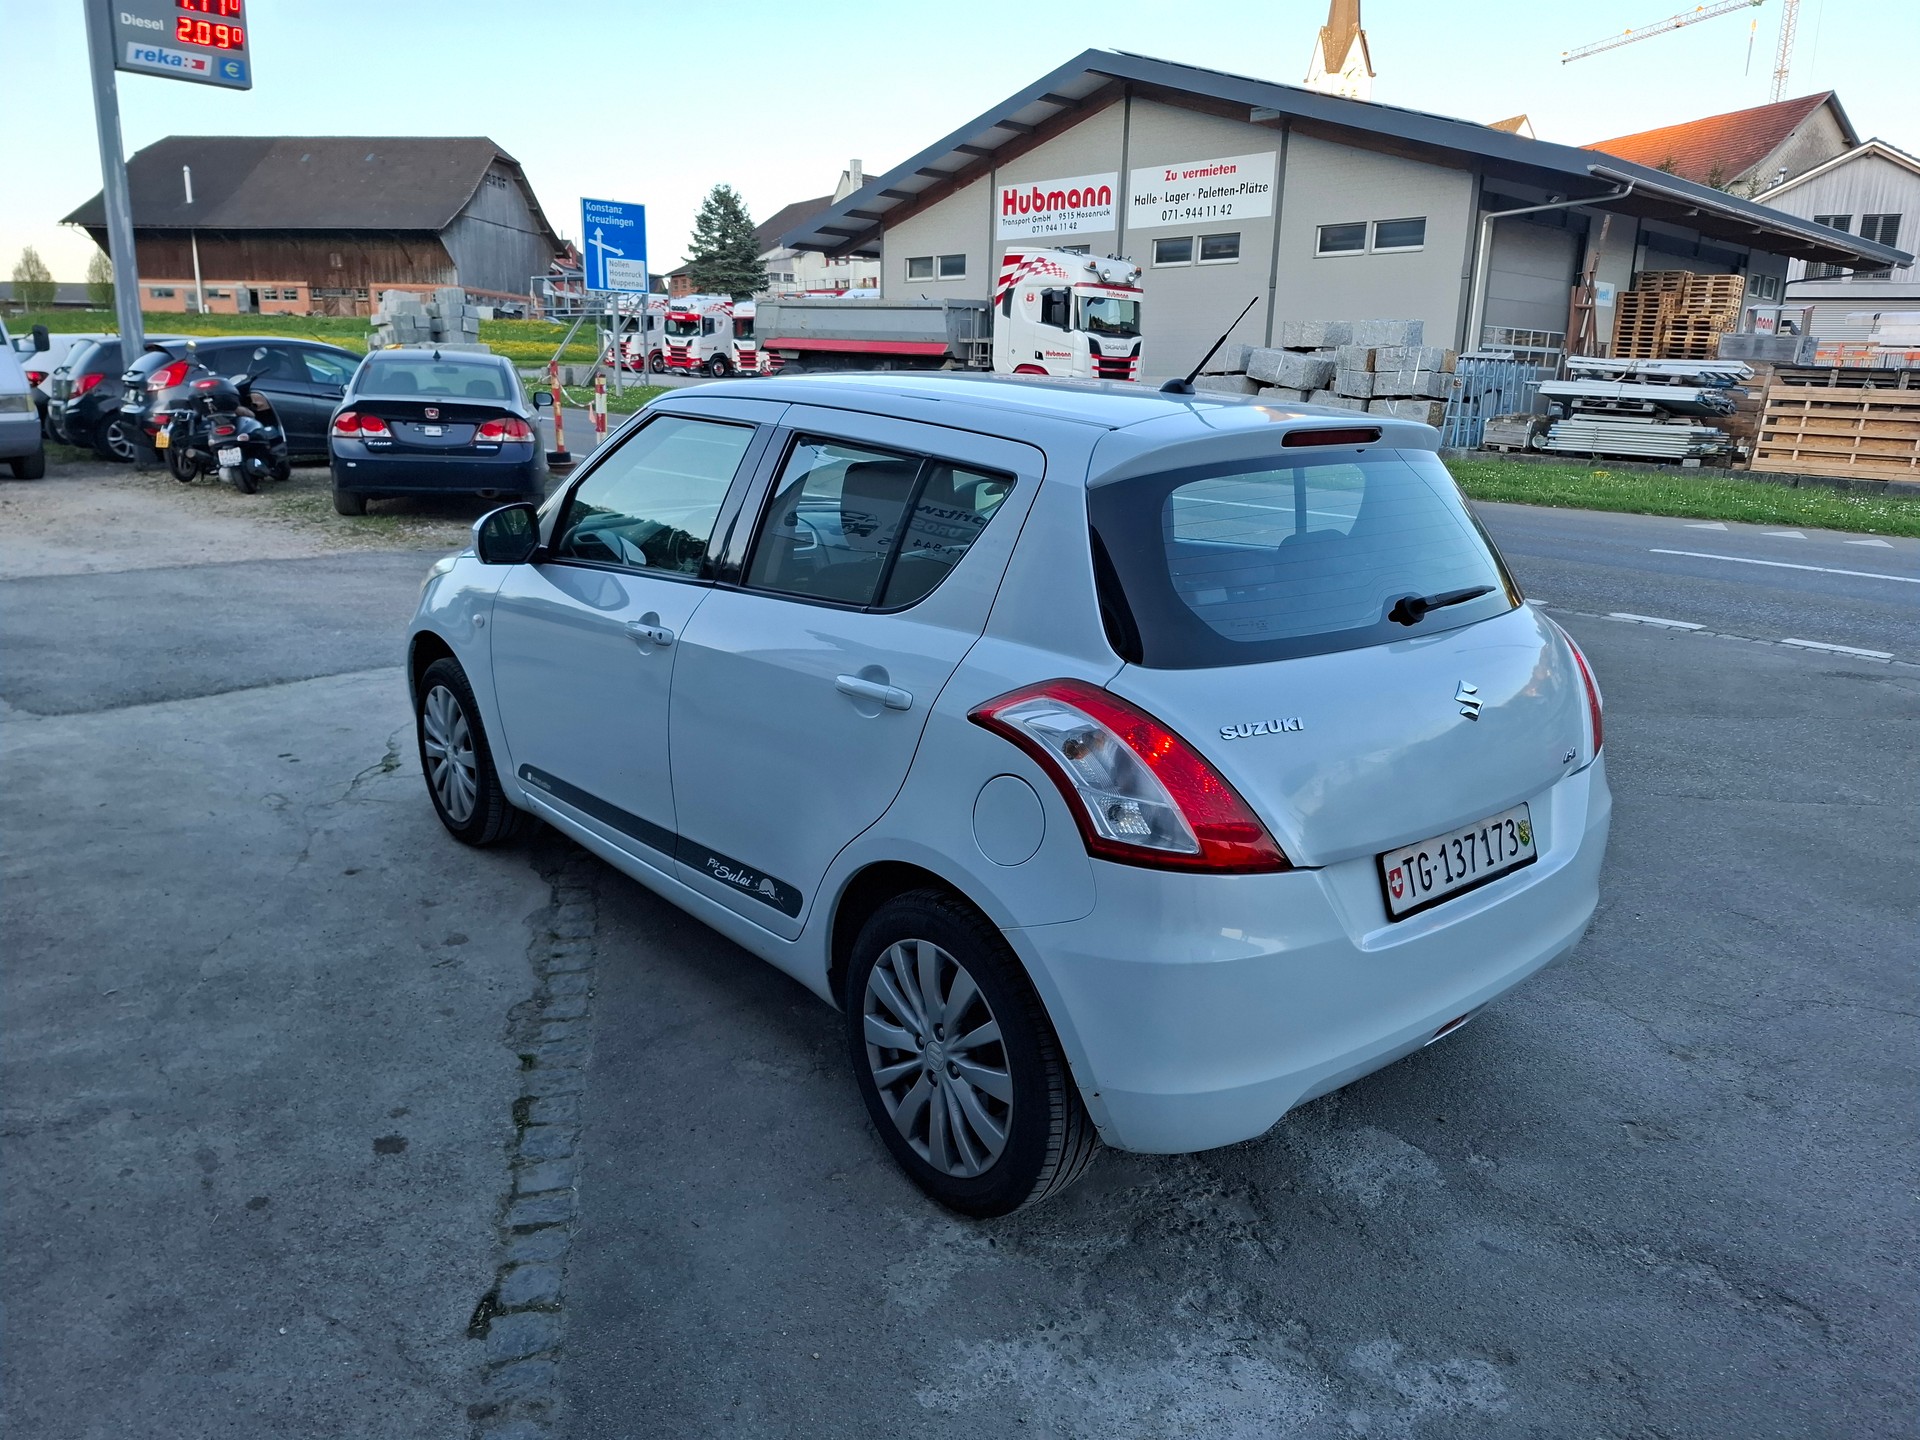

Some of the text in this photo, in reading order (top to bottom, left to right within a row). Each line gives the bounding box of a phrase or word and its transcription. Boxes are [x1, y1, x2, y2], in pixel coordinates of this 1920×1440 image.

[120, 12, 164, 31] Diesel
[1165, 164, 1236, 181] Zu vermieten
[1003, 185, 1111, 216] Hubmann
[1134, 182, 1268, 206] Halle Lager Paletten-Plätze
[585, 201, 623, 214] Konstanz
[1206, 205, 1216, 217] 11
[1220, 204, 1232, 215] 42
[586, 213, 634, 228] Kreuzlingen
[1002, 209, 1111, 227] Transport GmbH 9515 Hosenruck
[1031, 221, 1077, 234] 071 944 11 42
[609, 260, 630, 269] Nollen
[609, 278, 644, 288] Wuppenau
[1220, 716, 1304, 740] SUZUKI
[714, 866, 753, 887] Sulai
